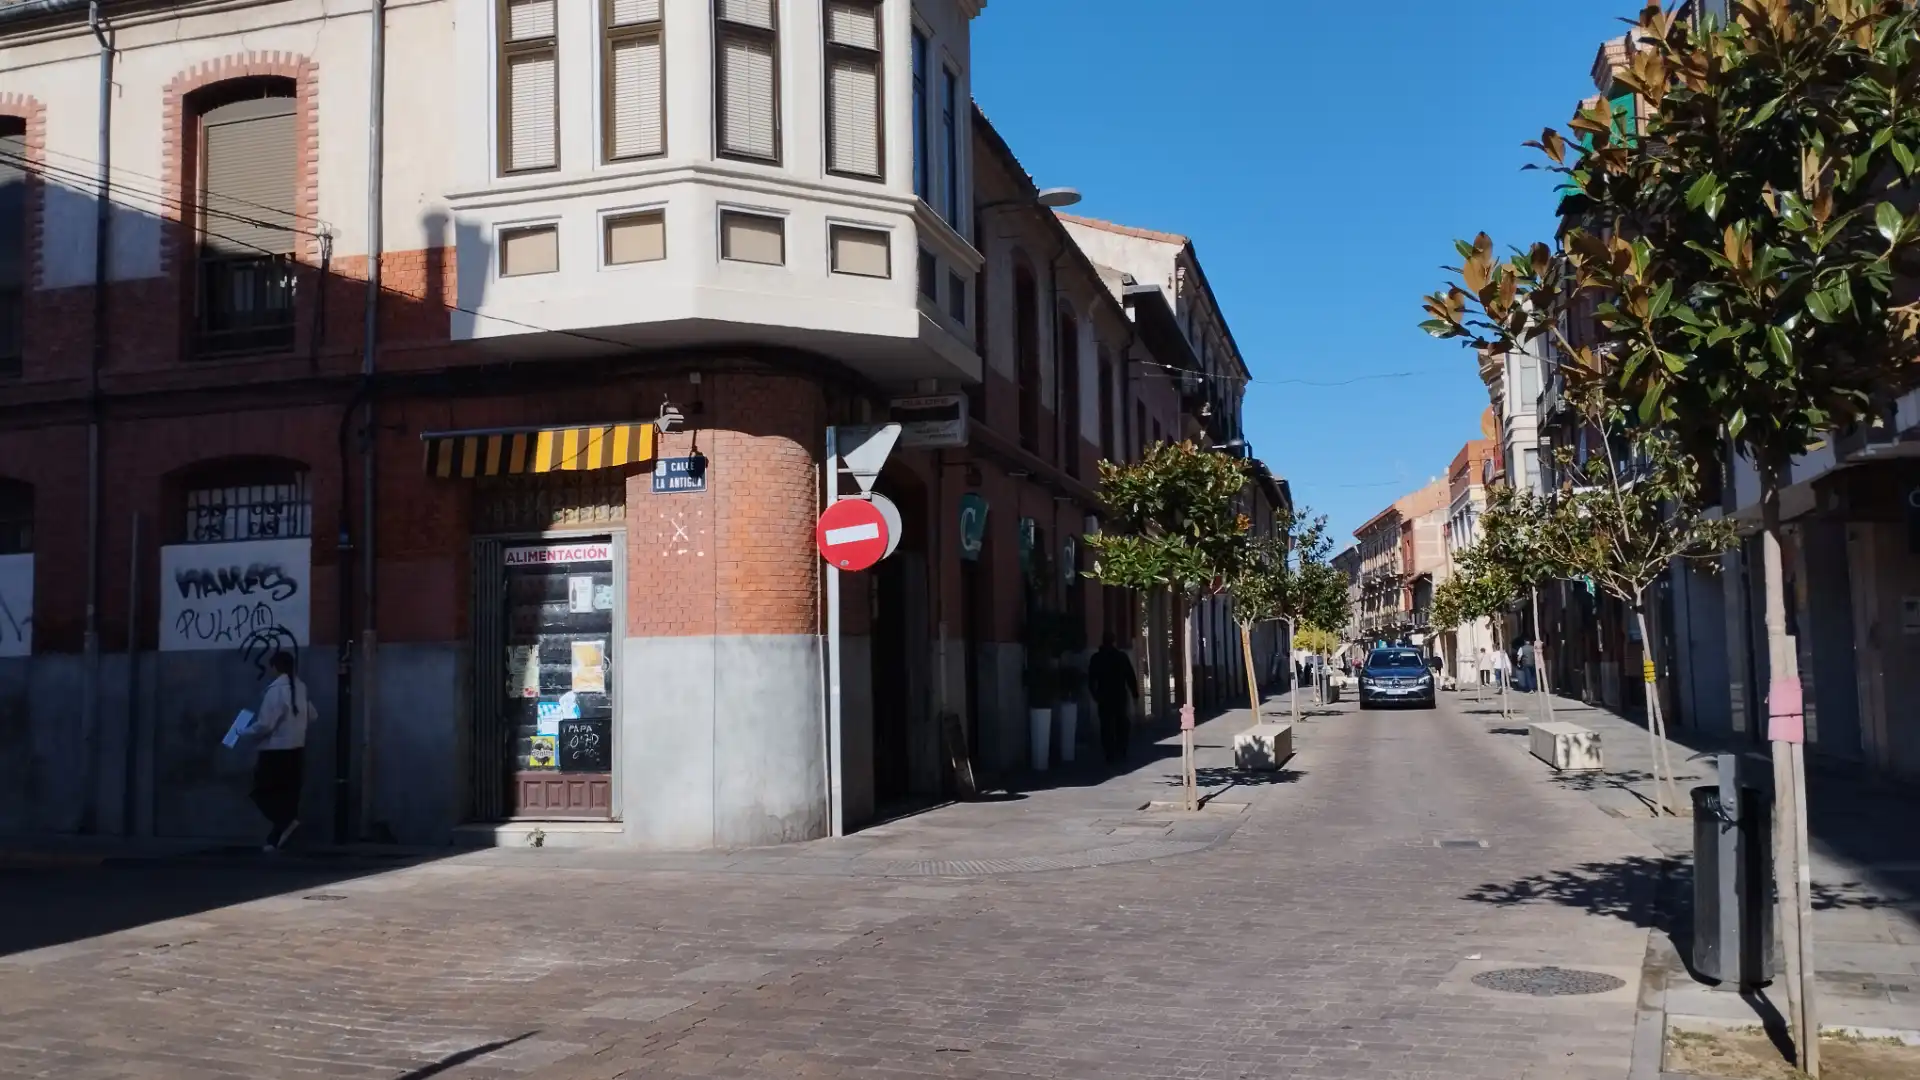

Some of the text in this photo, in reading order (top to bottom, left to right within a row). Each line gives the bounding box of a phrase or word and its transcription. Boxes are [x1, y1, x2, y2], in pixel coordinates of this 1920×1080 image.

[671, 461, 696, 472] CALLE
[656, 476, 702, 490] LA ANTIGUA
[507, 545, 608, 564] ALIMENTACIÓN
